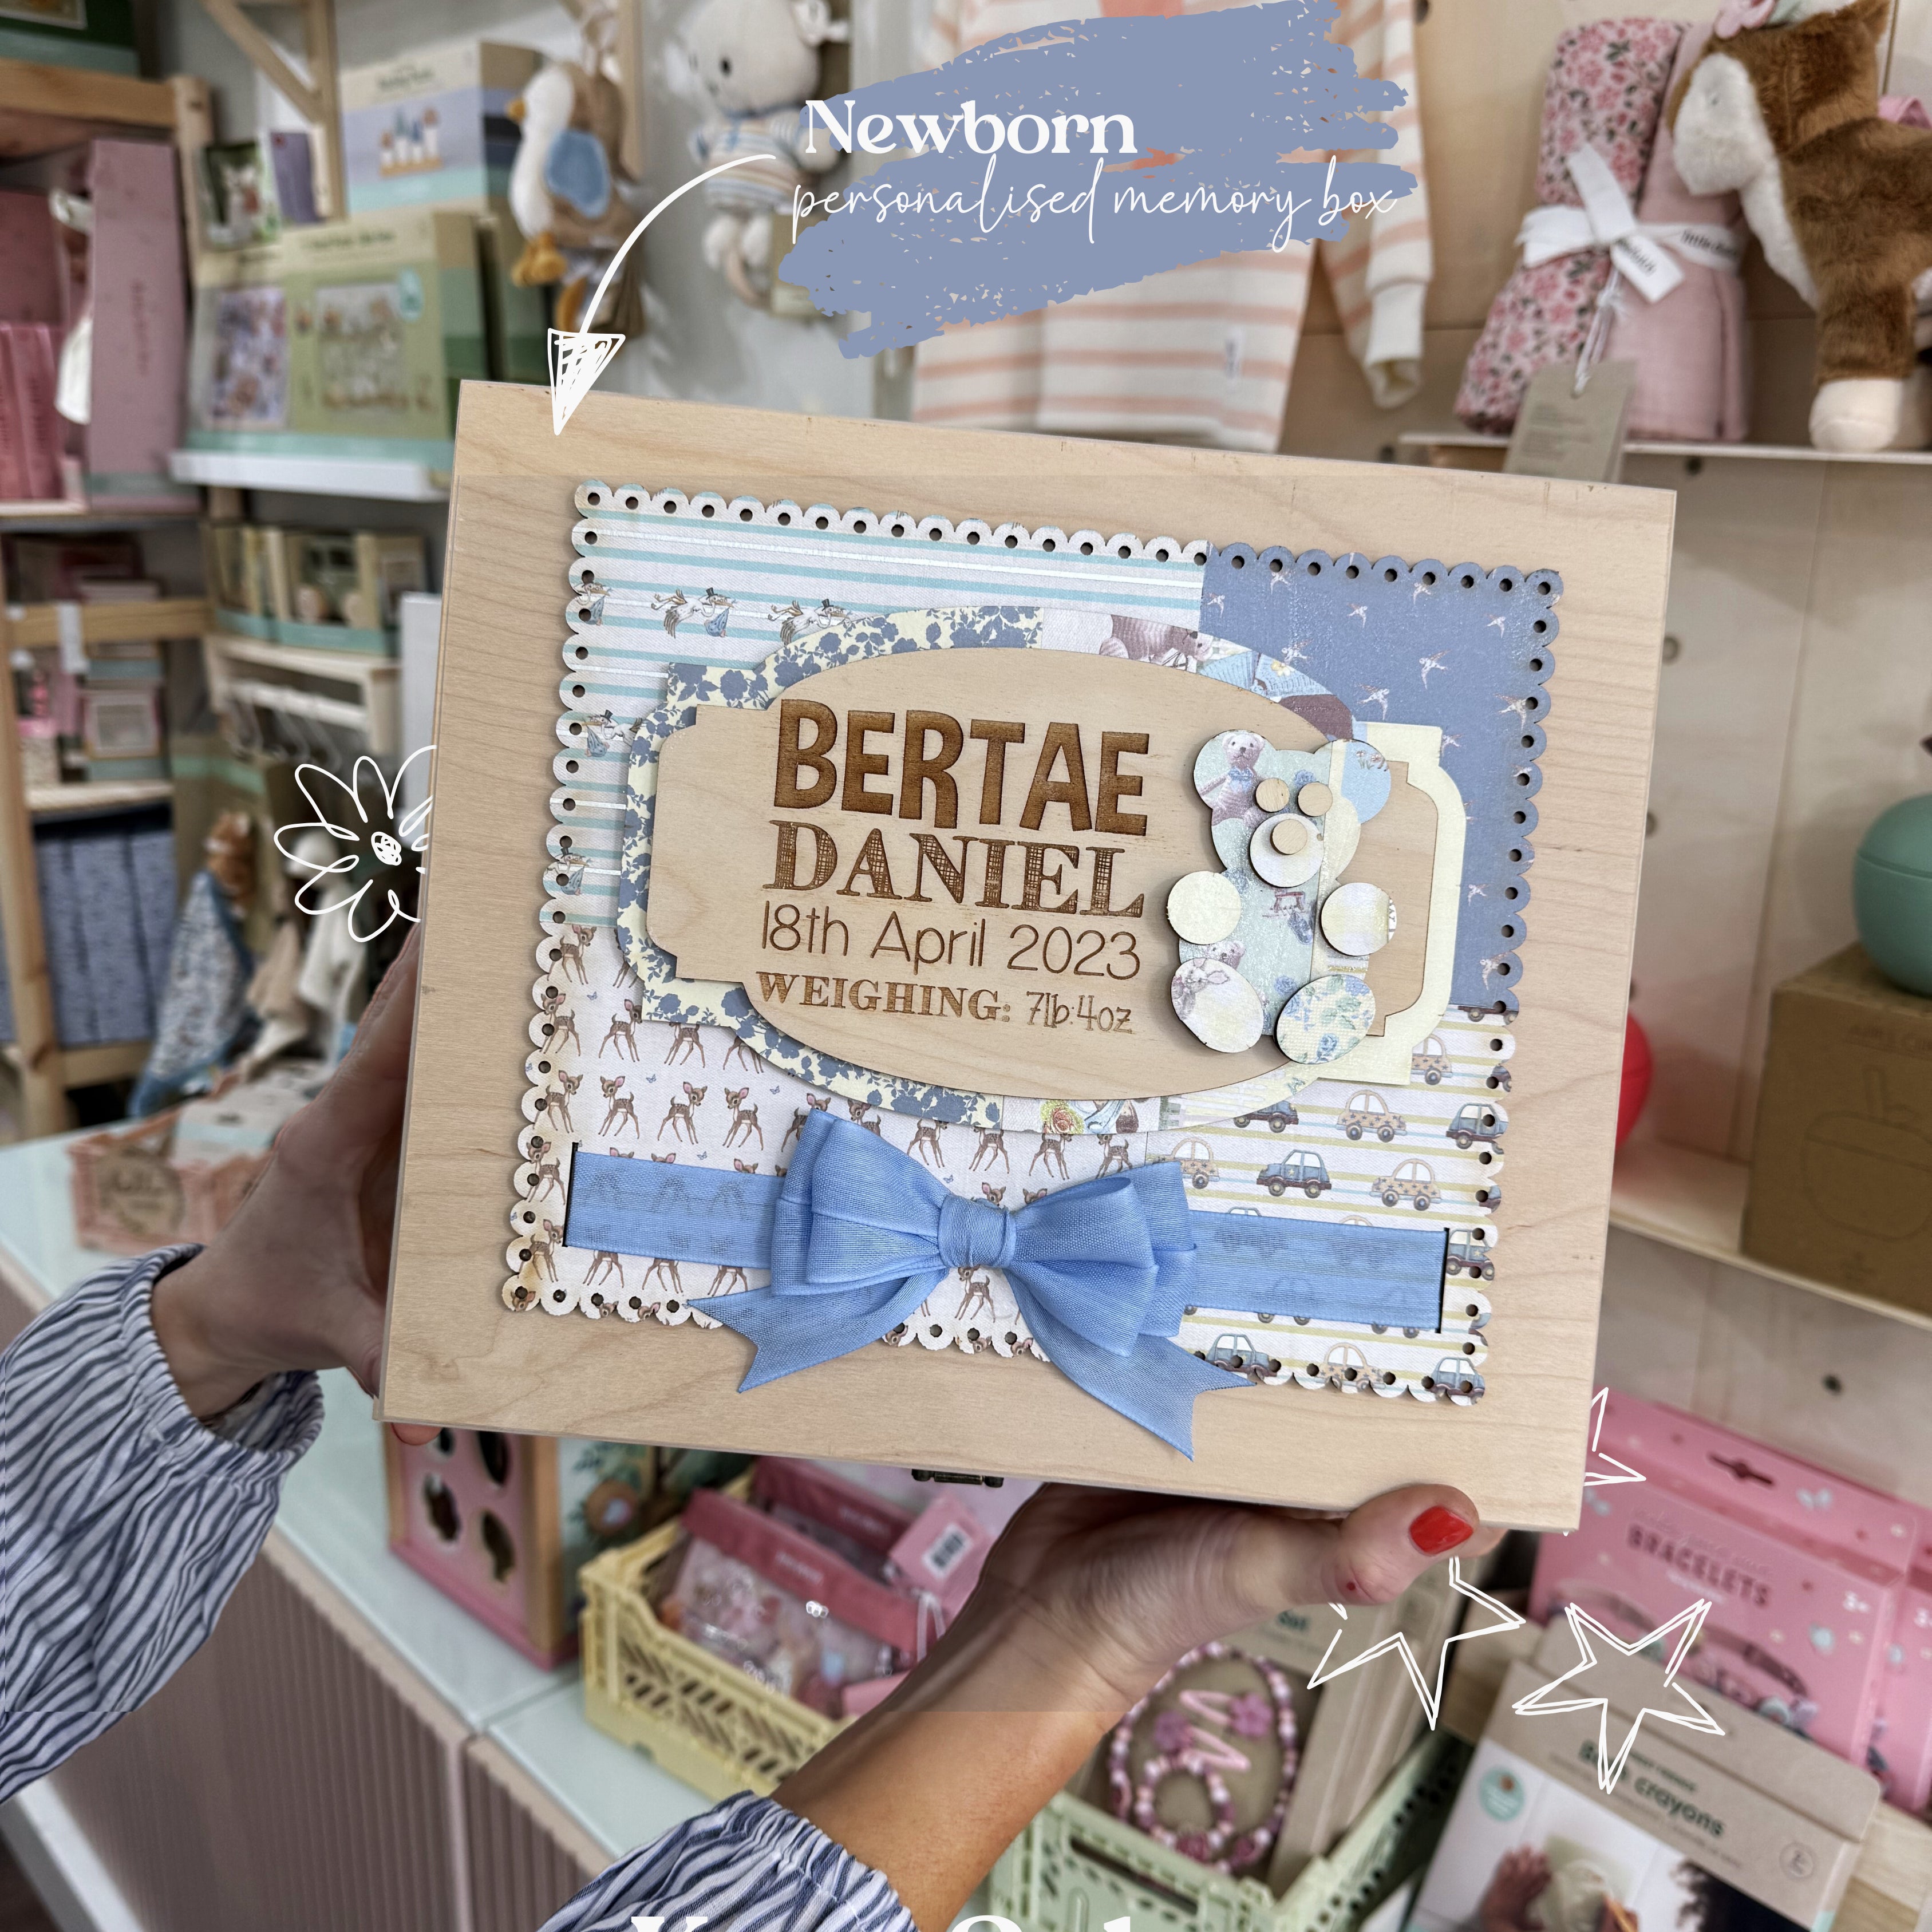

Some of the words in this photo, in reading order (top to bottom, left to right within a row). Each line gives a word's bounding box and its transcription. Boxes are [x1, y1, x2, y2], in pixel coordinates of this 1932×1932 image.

[773, 698, 1150, 836] BERTAE
[761, 819, 1145, 918] DANIEL
[761, 900, 850, 957] 18th
[870, 910, 986, 975] April
[1006, 923, 1141, 980] 2023
[756, 970, 1011, 1023] WEIGHING:
[1626, 1522, 1770, 1606] BRACELETS
[1633, 1776, 1724, 1836] crayons
